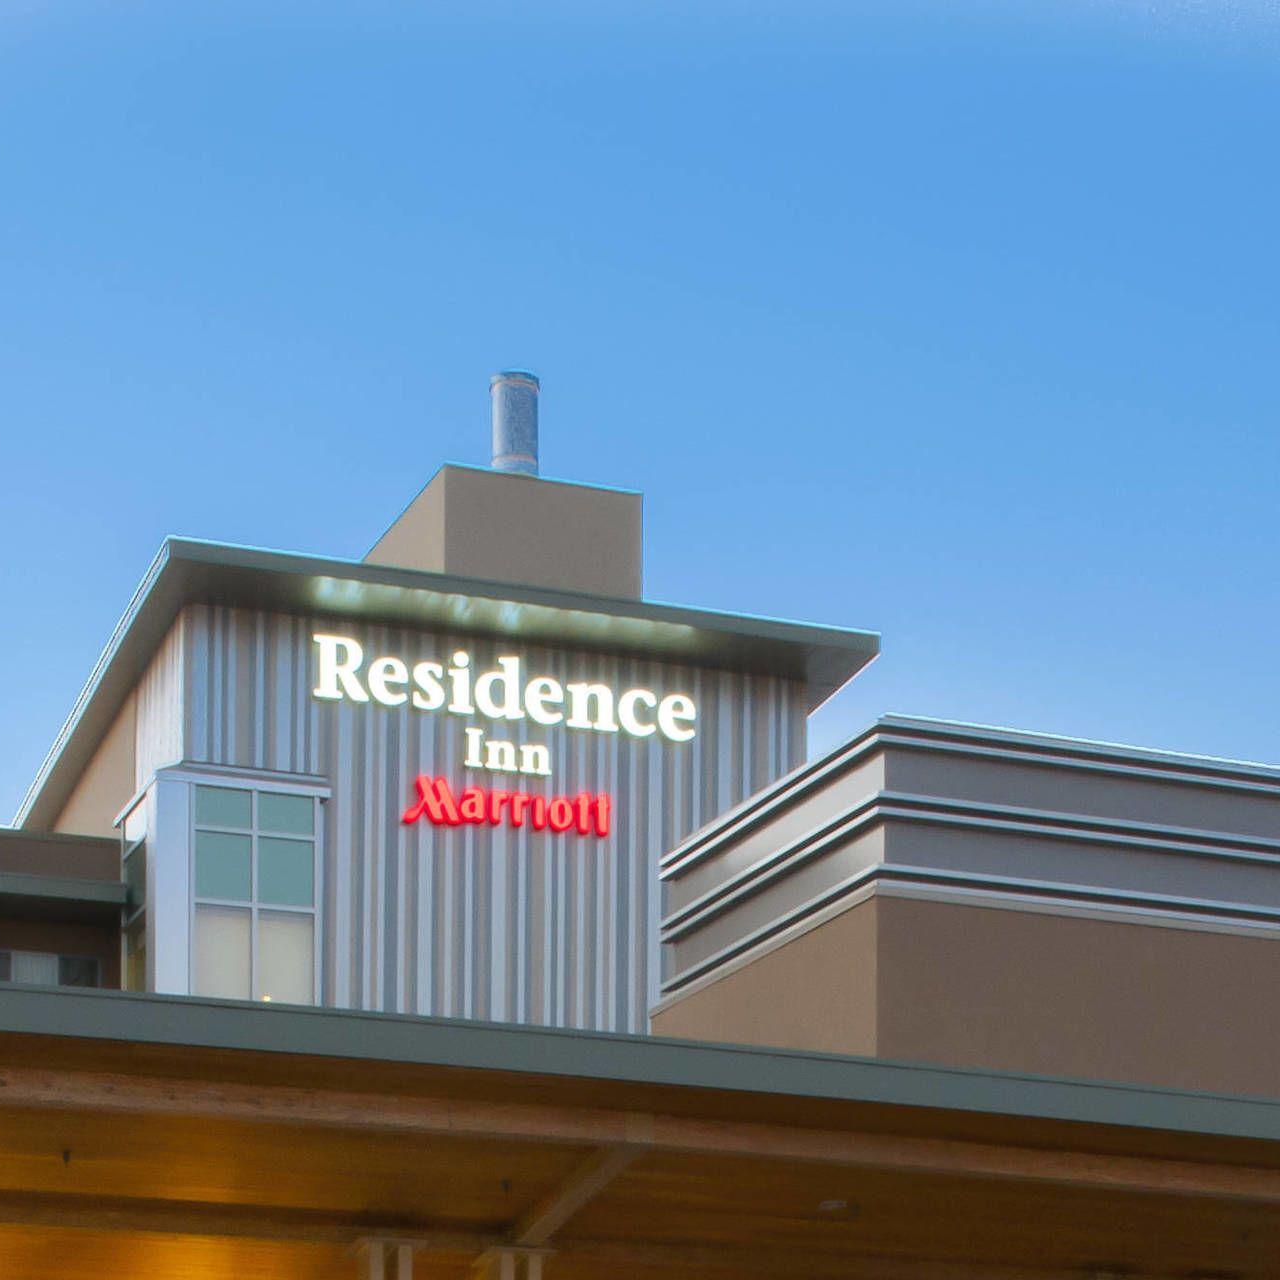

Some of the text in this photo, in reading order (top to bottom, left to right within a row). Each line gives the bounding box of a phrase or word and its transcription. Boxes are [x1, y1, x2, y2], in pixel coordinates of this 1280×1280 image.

[312, 634, 697, 742] Residence
[464, 727, 552, 776] Inn
[402, 775, 612, 838] Marriott
